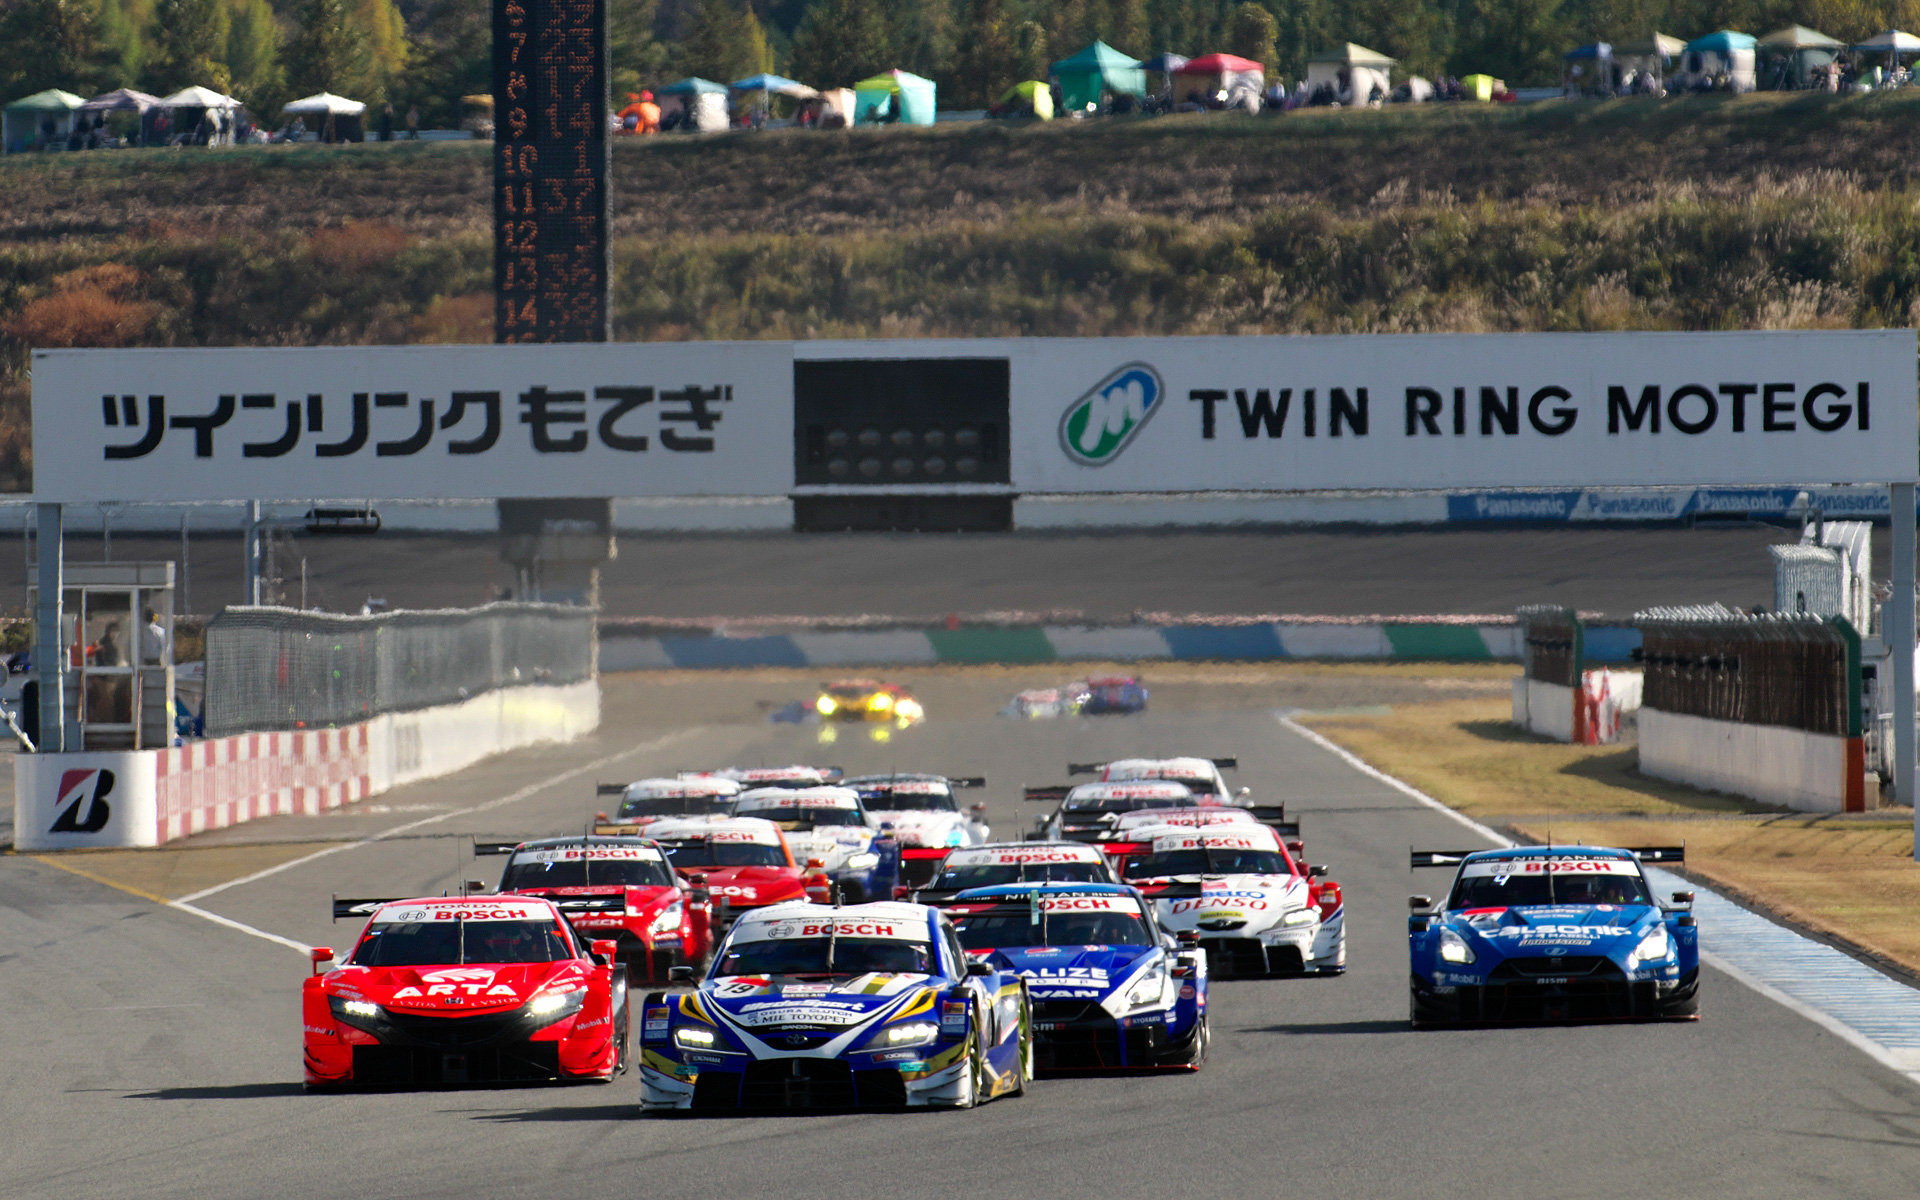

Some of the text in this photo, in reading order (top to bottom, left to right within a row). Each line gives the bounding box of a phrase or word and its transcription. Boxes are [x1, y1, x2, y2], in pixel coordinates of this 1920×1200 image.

[509, 32, 526, 63] 7
[545, 65, 595, 100] 17
[508, 107, 527, 139] 9
[502, 145, 538, 176] 10
[503, 178, 595, 214] 11 37
[502, 220, 538, 253] 12
[503, 257, 538, 291] 13
[503, 295, 538, 328] 14
[1189, 382, 1872, 439] TWIN RING MOTEGI
[102, 384, 733, 460] ツインリンクもてぎ
[1475, 492, 1567, 517] Panasonic
[1589, 491, 1678, 516] Panasonic
[1702, 489, 1786, 513] Panasonic
[779, 797, 836, 806] BOSCH
[1182, 839, 1252, 849] BOSCH
[565, 849, 639, 860] BOSCH
[1000, 853, 1079, 864] BOSCH
[544, 861, 554, 872] 7
[1524, 861, 1612, 873] BOSCH
[1493, 874, 1511, 887] 4
[709, 885, 757, 900] EOS
[423, 902, 501, 911] HONDA
[1038, 898, 1111, 910] OSCH
[1171, 896, 1268, 915] DENSO
[434, 908, 529, 921] BOSCH
[802, 924, 893, 936] BOSCH
[1449, 972, 1475, 984] Mobil
[1627, 970, 1651, 982] Mobil
[392, 983, 517, 999] ARTA
[721, 983, 755, 994] 19
[739, 999, 866, 1013] WedsSport
[808, 1008, 853, 1017] CLUTCH
[576, 1018, 602, 1031] Mobil
[762, 1014, 849, 1024] MIE TOYOPET
